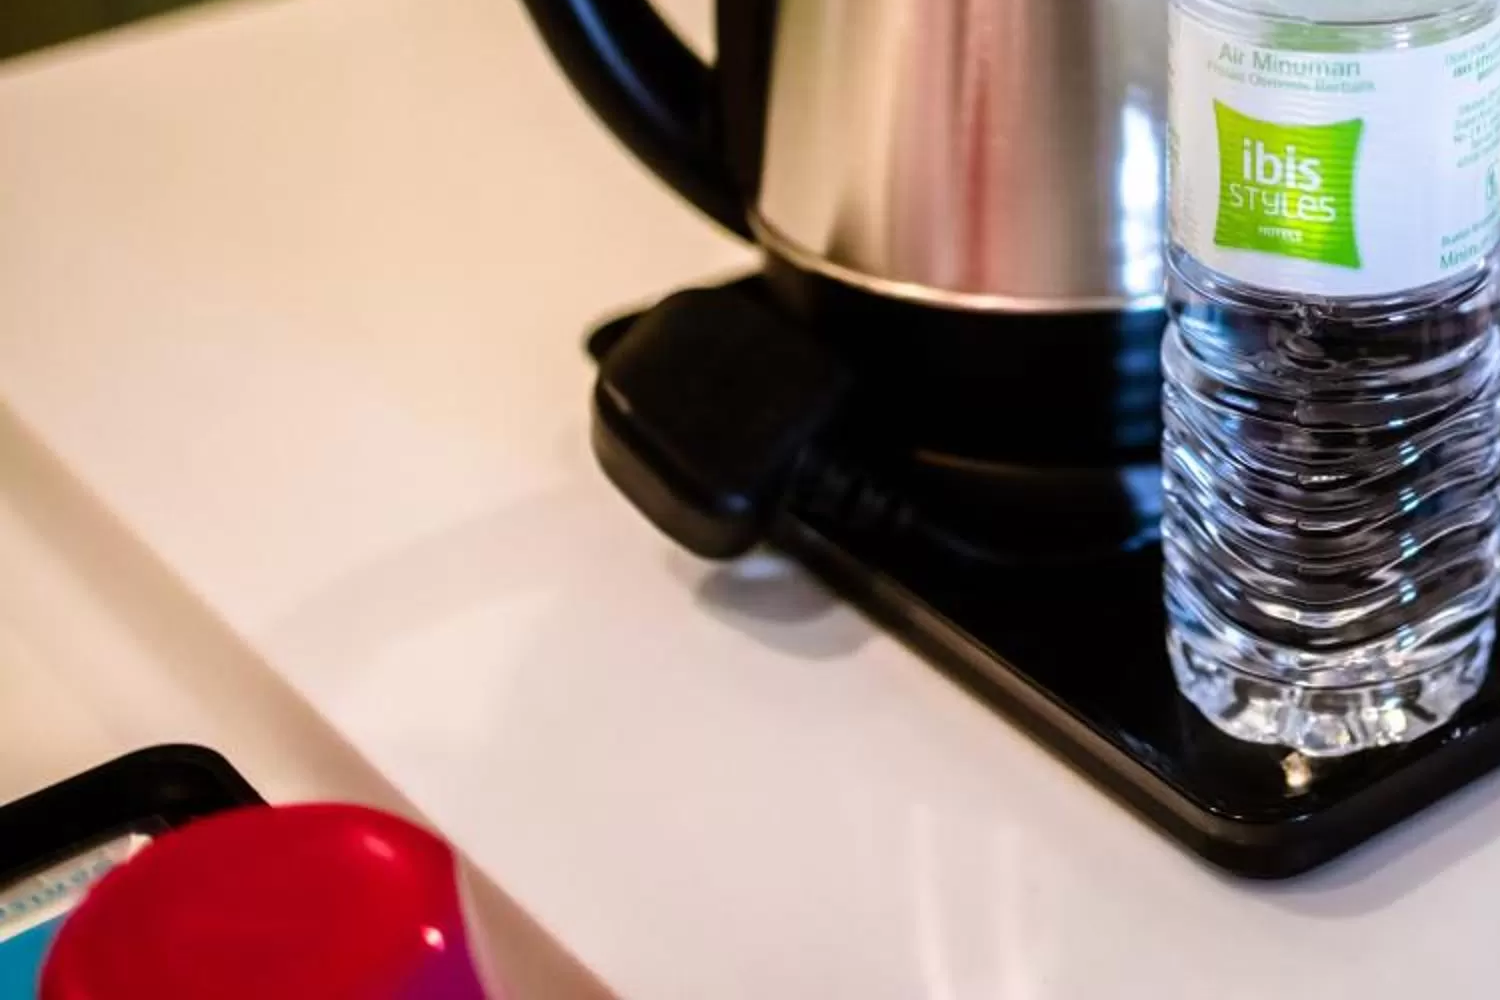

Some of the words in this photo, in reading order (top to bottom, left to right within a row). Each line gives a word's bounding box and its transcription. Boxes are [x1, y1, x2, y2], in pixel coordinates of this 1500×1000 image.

[1218, 41, 1245, 66] Air
[1252, 51, 1361, 77] Minuman
[1243, 137, 1322, 192] ibis
